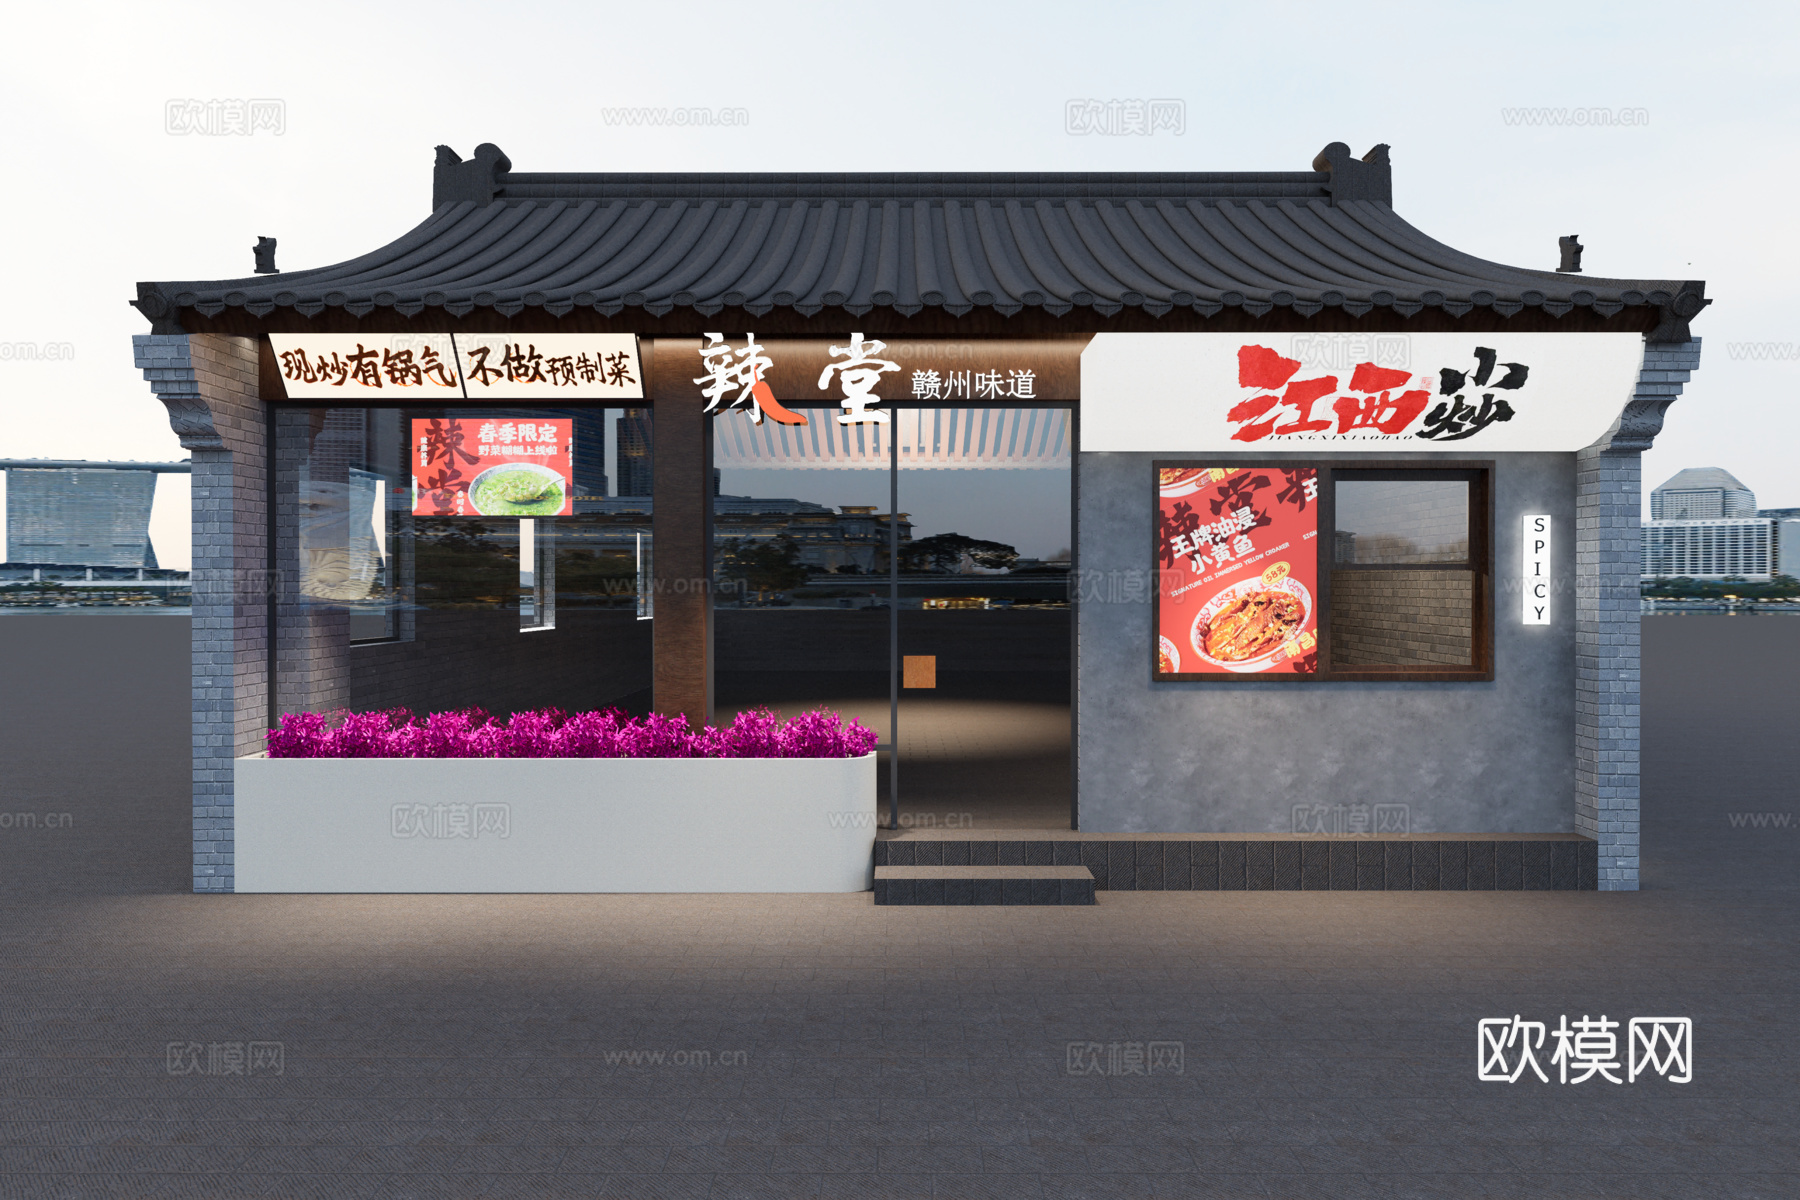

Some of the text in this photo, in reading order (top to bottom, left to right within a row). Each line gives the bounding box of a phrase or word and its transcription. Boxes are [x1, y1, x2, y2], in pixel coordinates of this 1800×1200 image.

[279, 343, 457, 388] 现炒有锅气
[467, 343, 636, 387] 不做预制菜
[911, 369, 1036, 400] 赣州味道
[477, 422, 558, 444] 春季限定
[1170, 505, 1257, 559] 王牌油浸
[1171, 541, 1290, 597] SIGNATURE OIL IMMERSED YELLOW CROAKER
[1191, 534, 1256, 575] 小黄鱼
[1265, 564, 1287, 582] 58元
[1534, 517, 1546, 620] SPICY
[1284, 628, 1317, 659] 南昌
